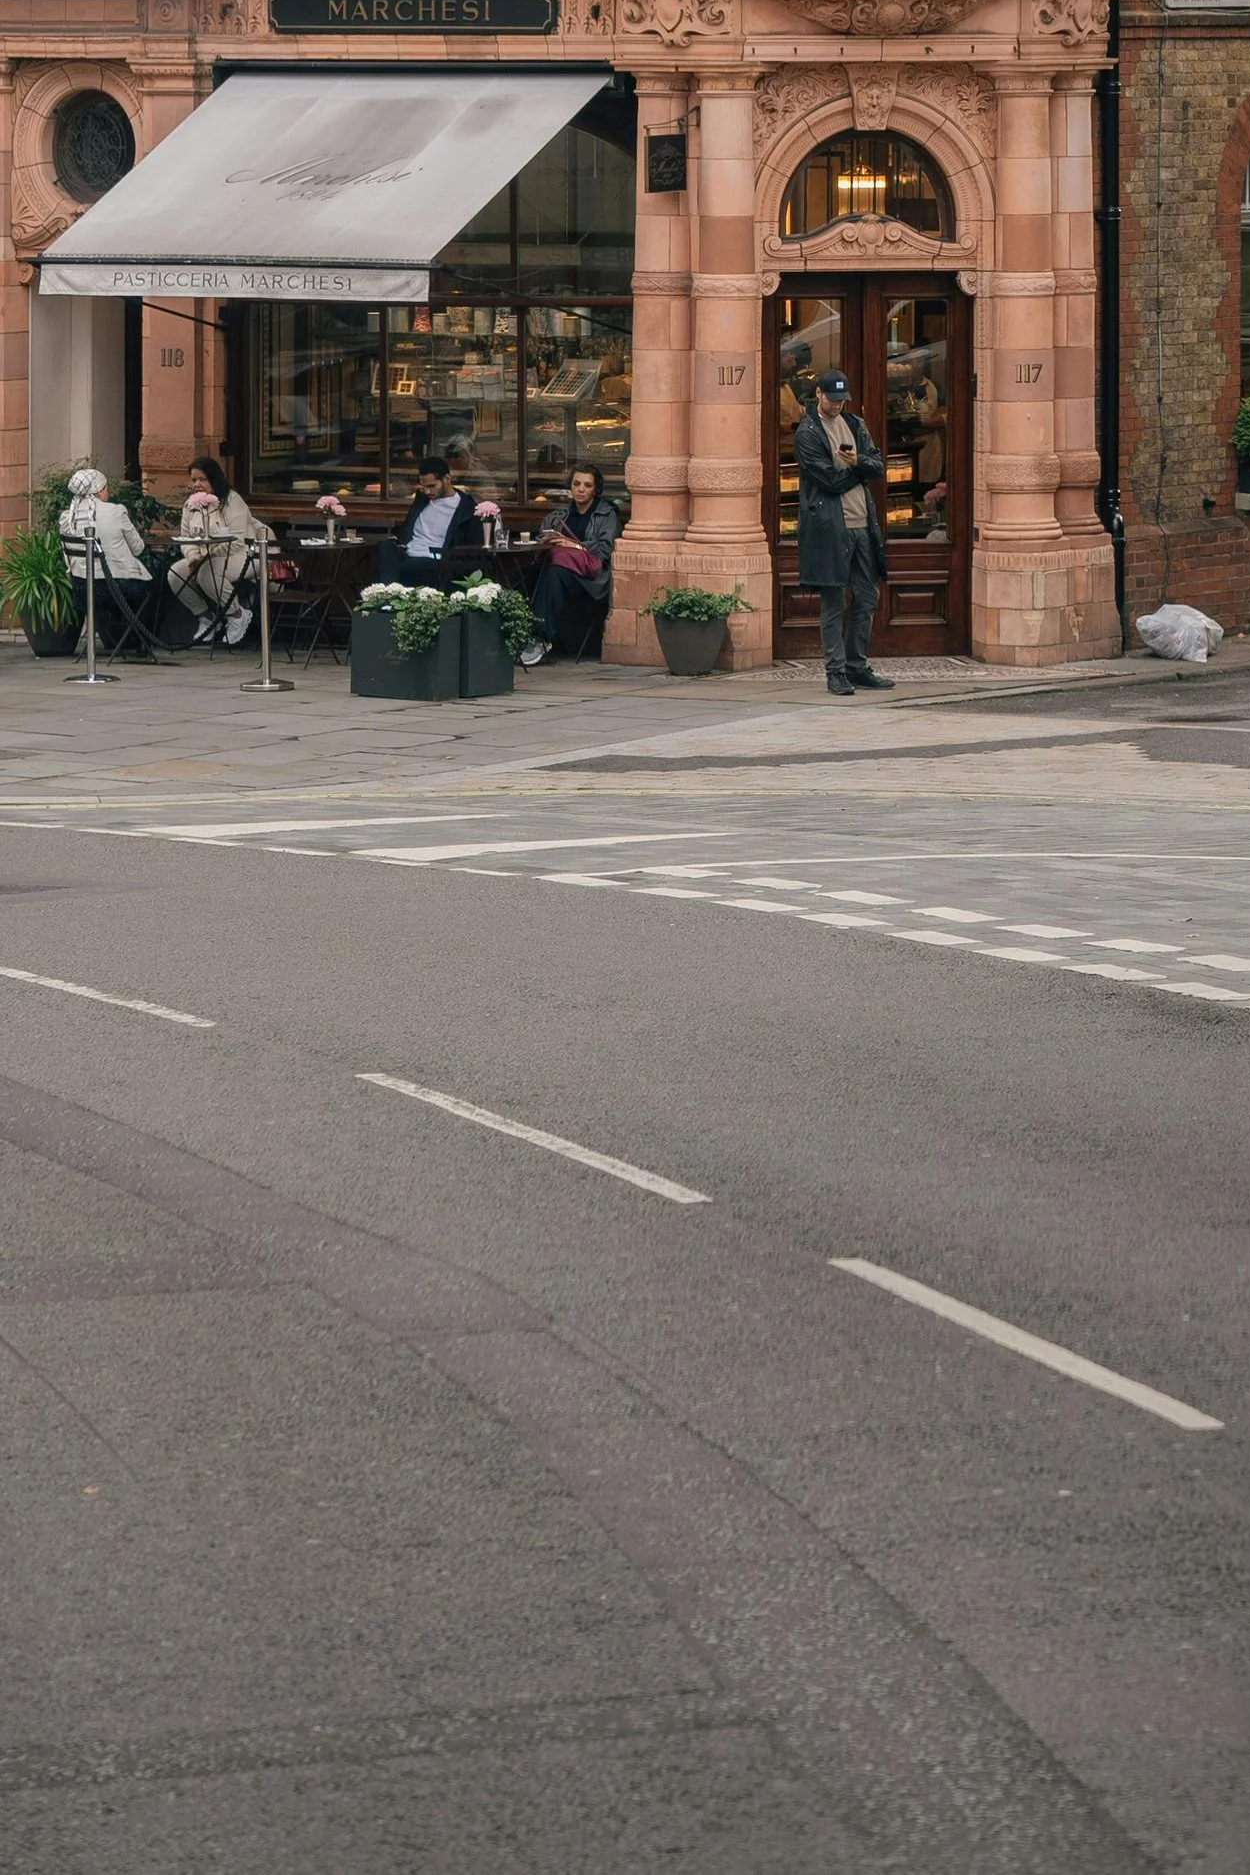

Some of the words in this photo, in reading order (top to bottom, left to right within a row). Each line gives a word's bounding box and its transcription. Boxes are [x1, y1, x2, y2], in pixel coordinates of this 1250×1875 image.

[327, 0, 490, 22] MARCHESI
[225, 152, 424, 186] Marchesi
[112, 272, 229, 288] PASTICCERIA
[240, 273, 352, 291] MARCHESI
[160, 348, 185, 367] 118
[718, 365, 746, 386] 117
[1014, 363, 1044, 384] 117
